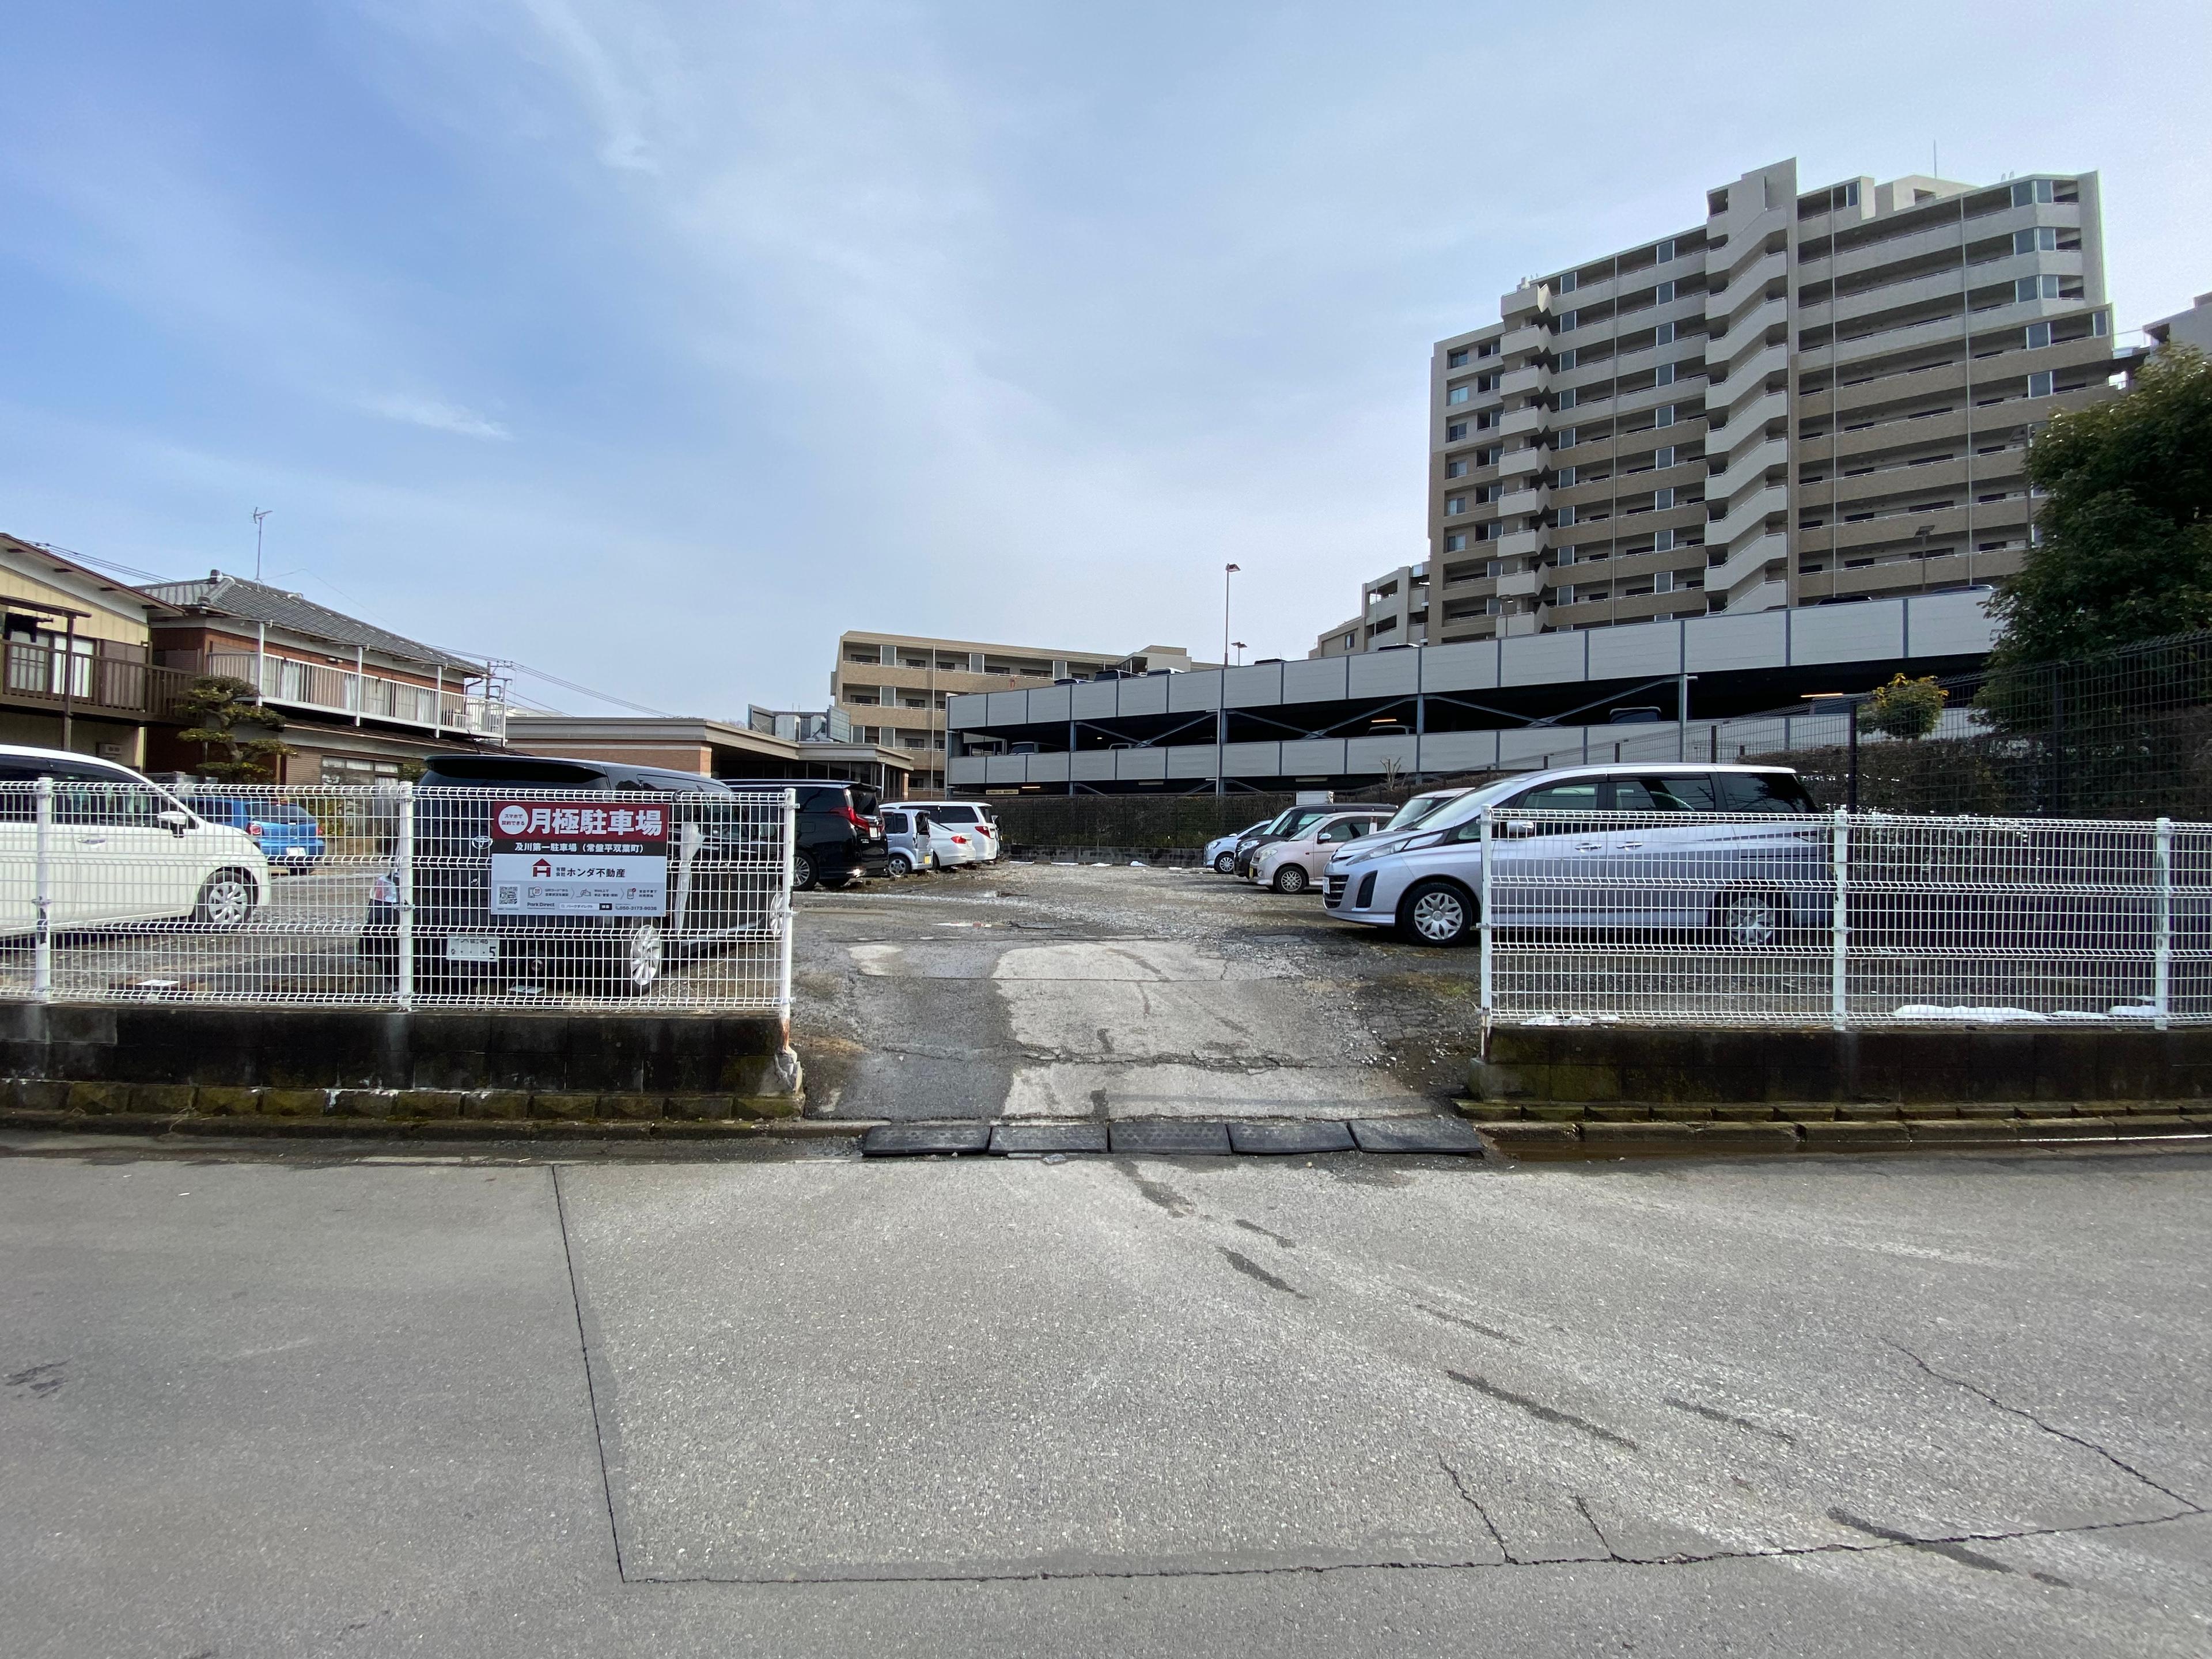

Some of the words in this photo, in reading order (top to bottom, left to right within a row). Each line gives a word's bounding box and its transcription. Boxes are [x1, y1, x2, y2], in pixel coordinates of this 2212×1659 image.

[527, 808, 662, 836] 月極駐車場
[567, 868, 626, 878] ホンダ不動産
